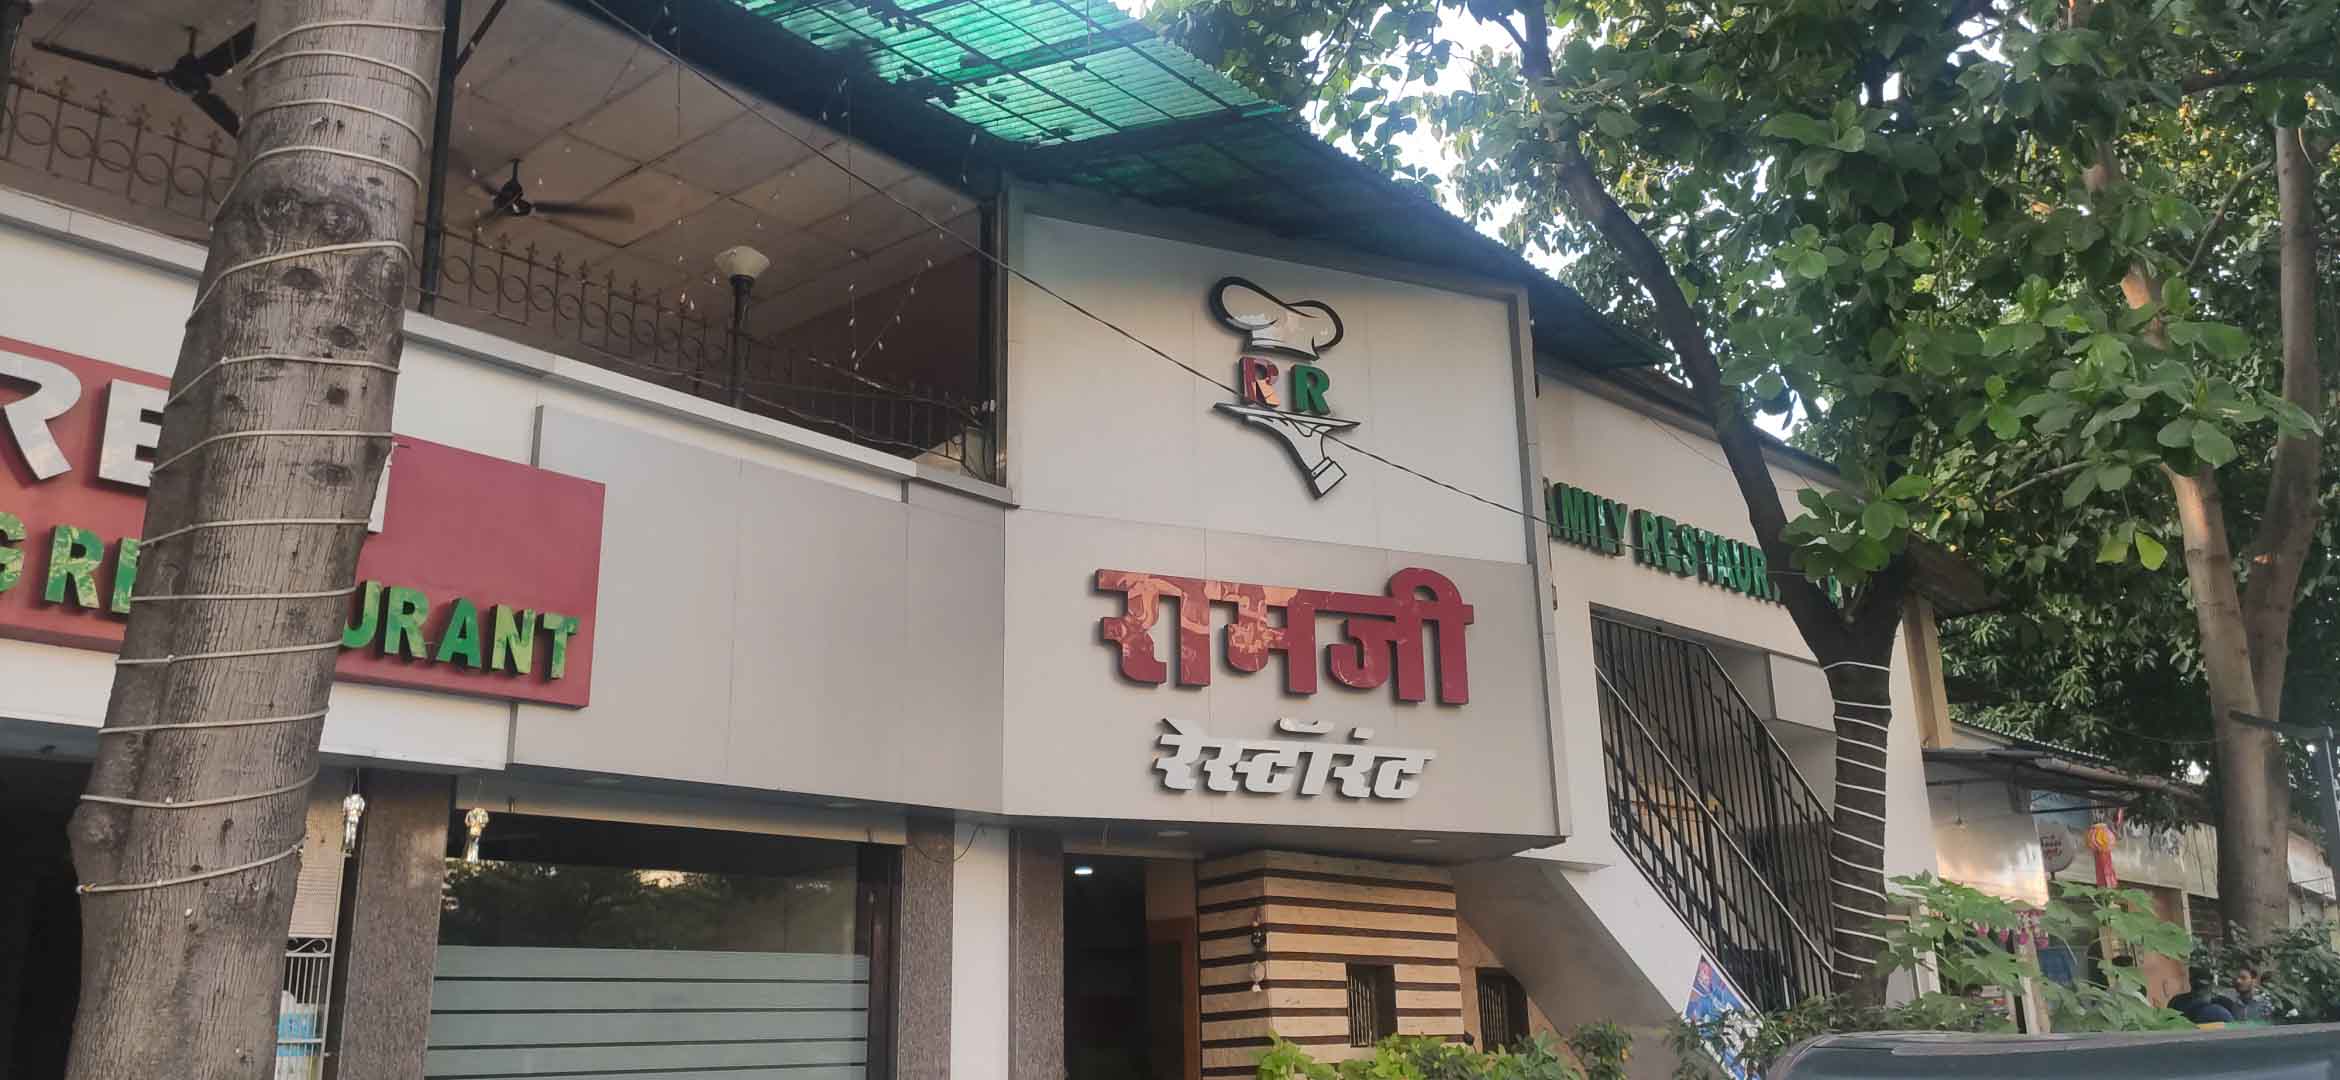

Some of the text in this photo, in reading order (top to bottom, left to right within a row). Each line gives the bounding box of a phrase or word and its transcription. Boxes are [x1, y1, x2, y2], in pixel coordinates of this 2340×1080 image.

[1632, 509, 1844, 608] RESTAUR
[1095, 567, 1474, 706] रामजी
[1152, 717, 1437, 800] रेस्टॉरंट
